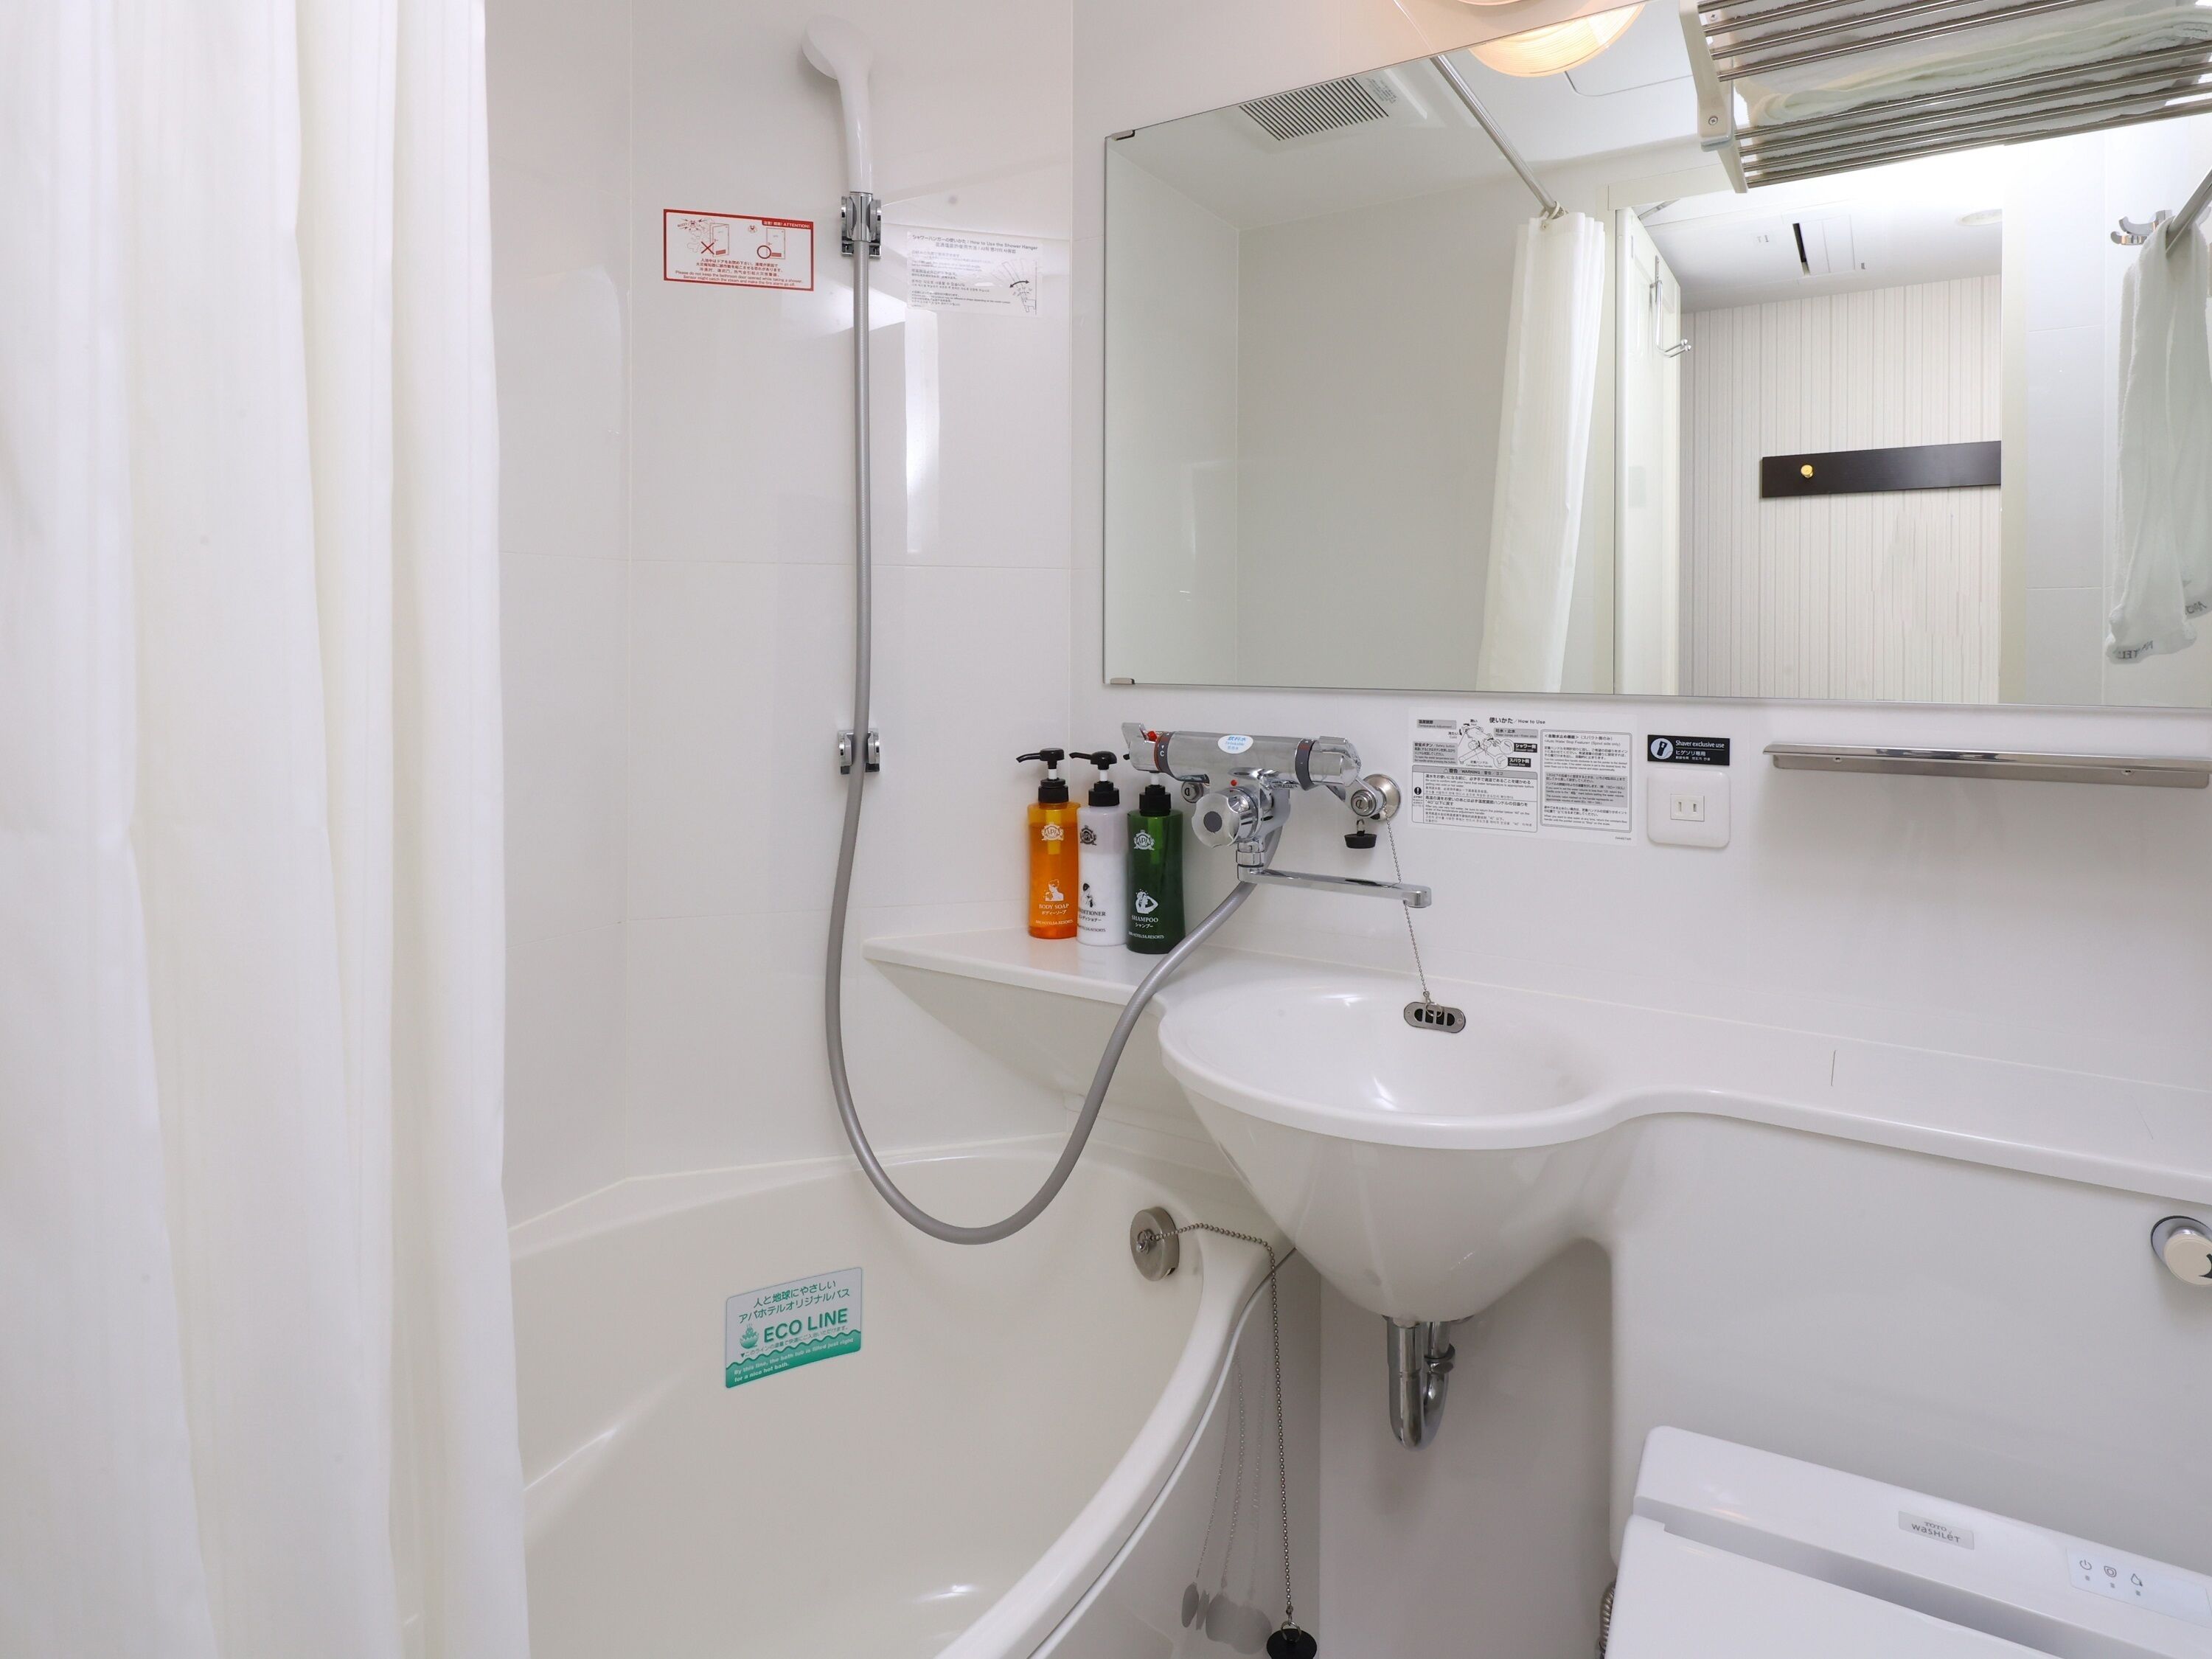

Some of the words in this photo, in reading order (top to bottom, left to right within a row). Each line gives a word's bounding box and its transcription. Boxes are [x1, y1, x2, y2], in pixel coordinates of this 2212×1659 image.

[1132, 914, 1158, 923] SHAMPOO
[739, 1288, 850, 1324] アパホテルオリジナルバス
[754, 1281, 836, 1308] 人と地球にやさしい
[764, 1319, 802, 1343] ECO
[807, 1308, 848, 1331] LINE
[780, 1354, 793, 1362] bath
[812, 1343, 827, 1352] filled
[827, 1341, 839, 1350] just
[840, 1338, 854, 1346] right
[1924, 1521, 1947, 1531] TOTO
